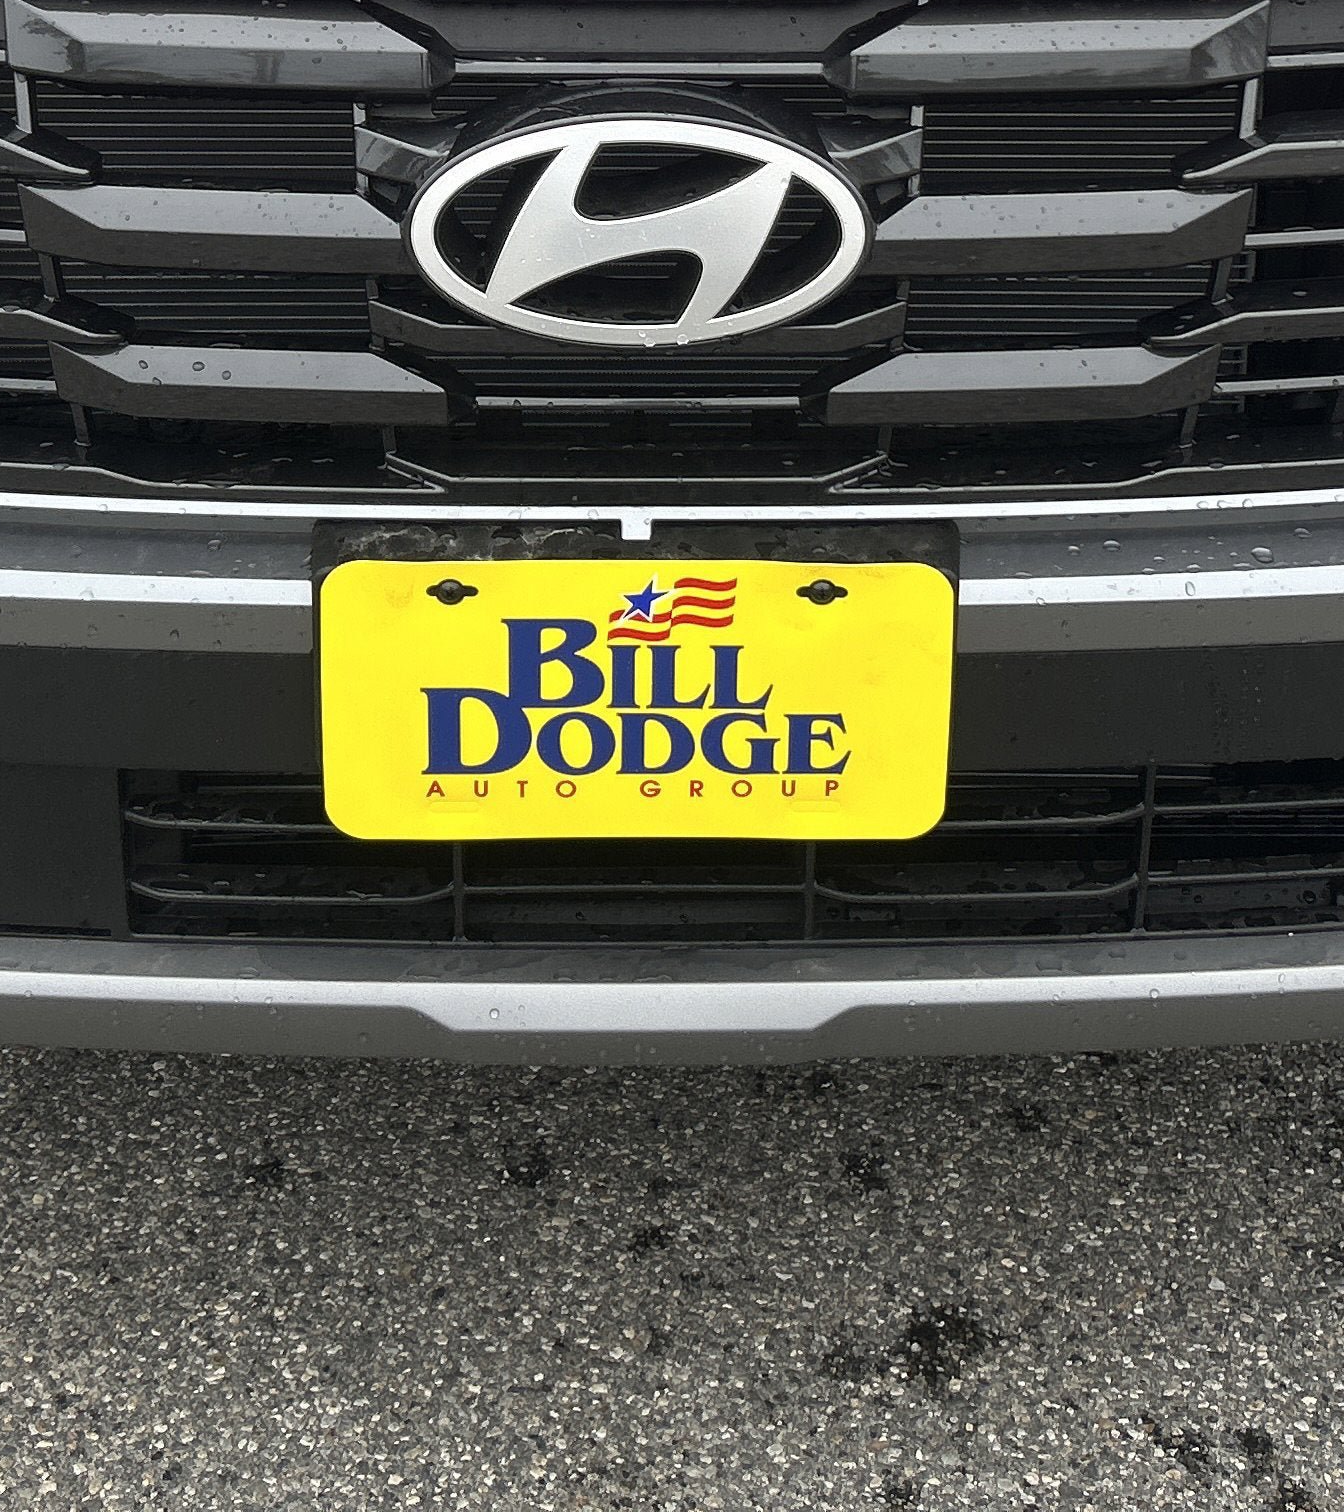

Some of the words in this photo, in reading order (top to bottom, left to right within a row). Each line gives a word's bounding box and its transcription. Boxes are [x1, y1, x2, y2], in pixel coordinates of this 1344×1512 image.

[501, 618, 773, 710] BILL
[421, 687, 852, 776] DODGE
[426, 779, 577, 799] AUTO
[639, 779, 841, 799] GROUP
